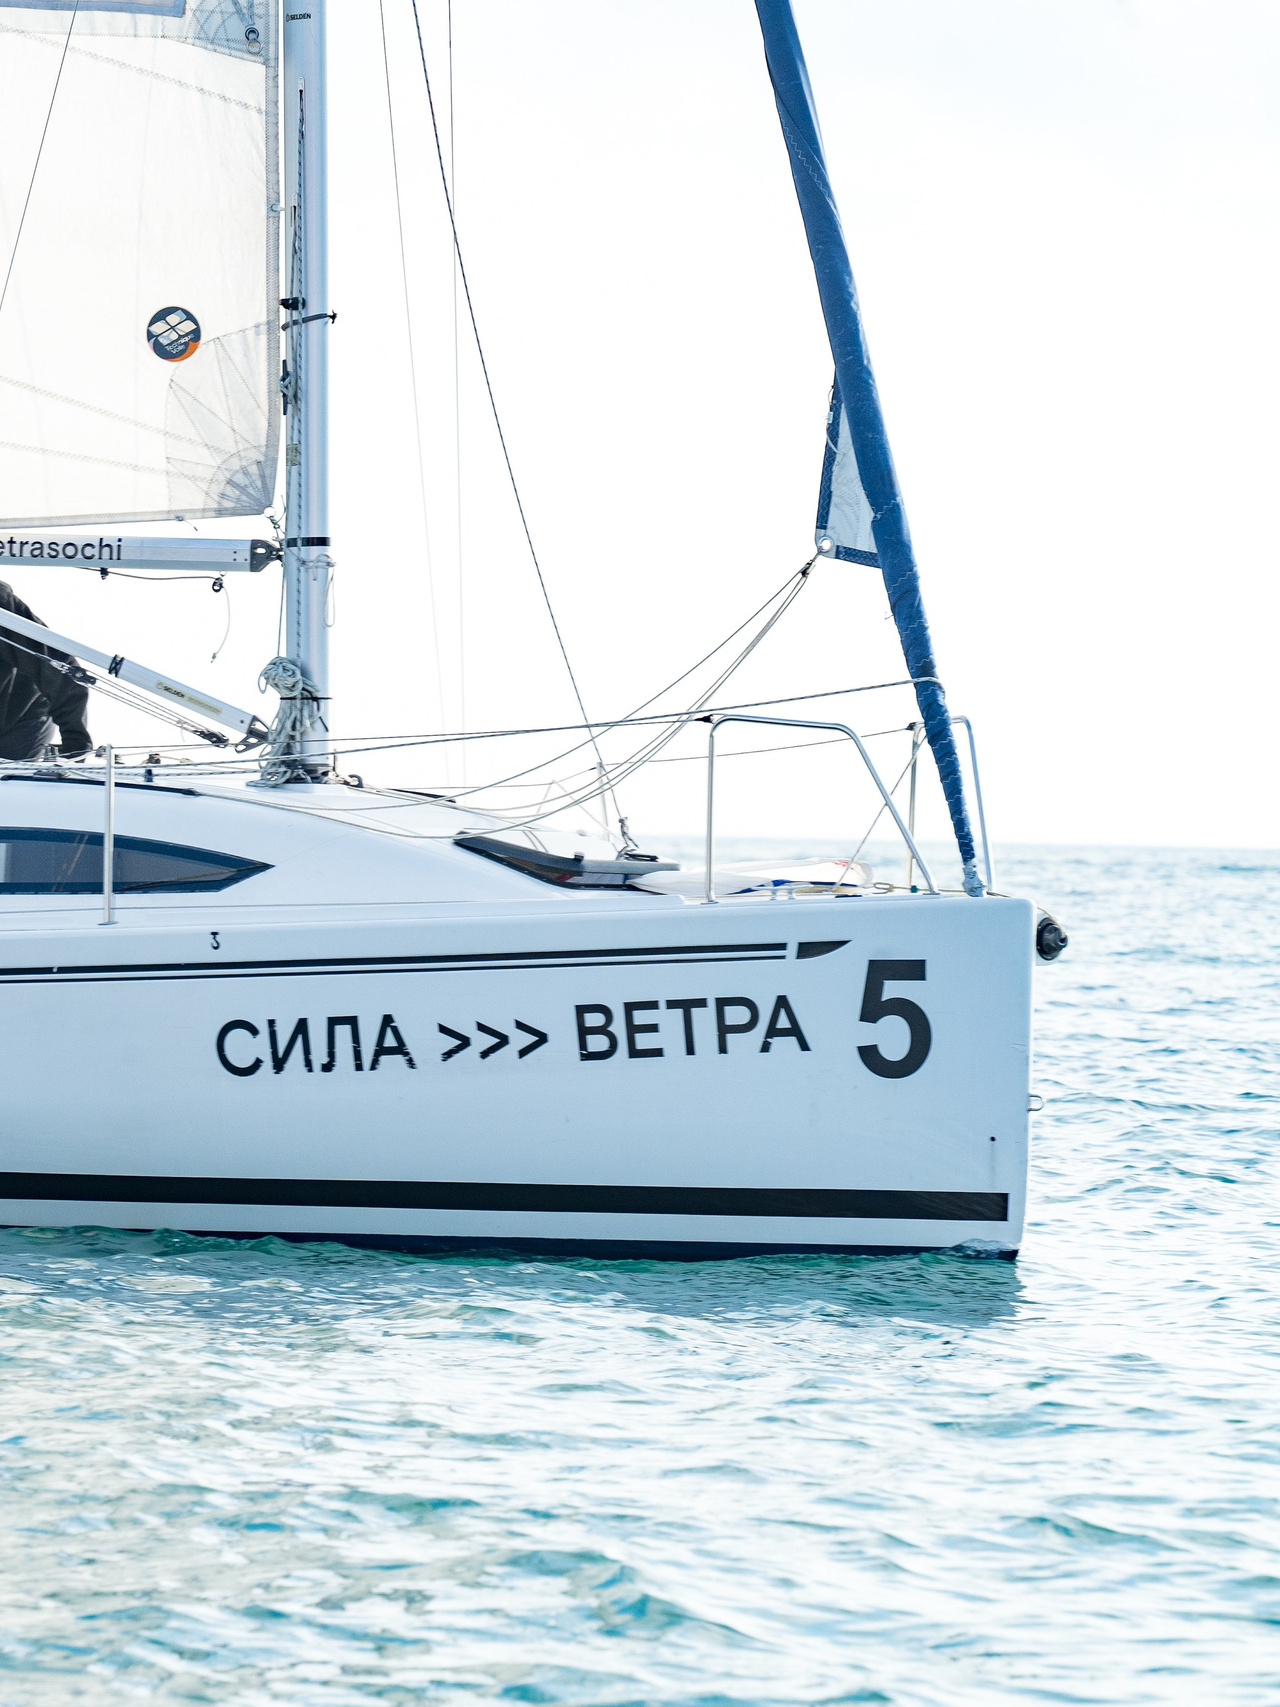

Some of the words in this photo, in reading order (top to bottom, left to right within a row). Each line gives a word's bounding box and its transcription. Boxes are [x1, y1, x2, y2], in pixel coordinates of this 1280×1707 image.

[216, 1013, 418, 1078] СИЛА
[574, 994, 812, 1062] ВЕТРА
[856, 959, 932, 1080] 5
